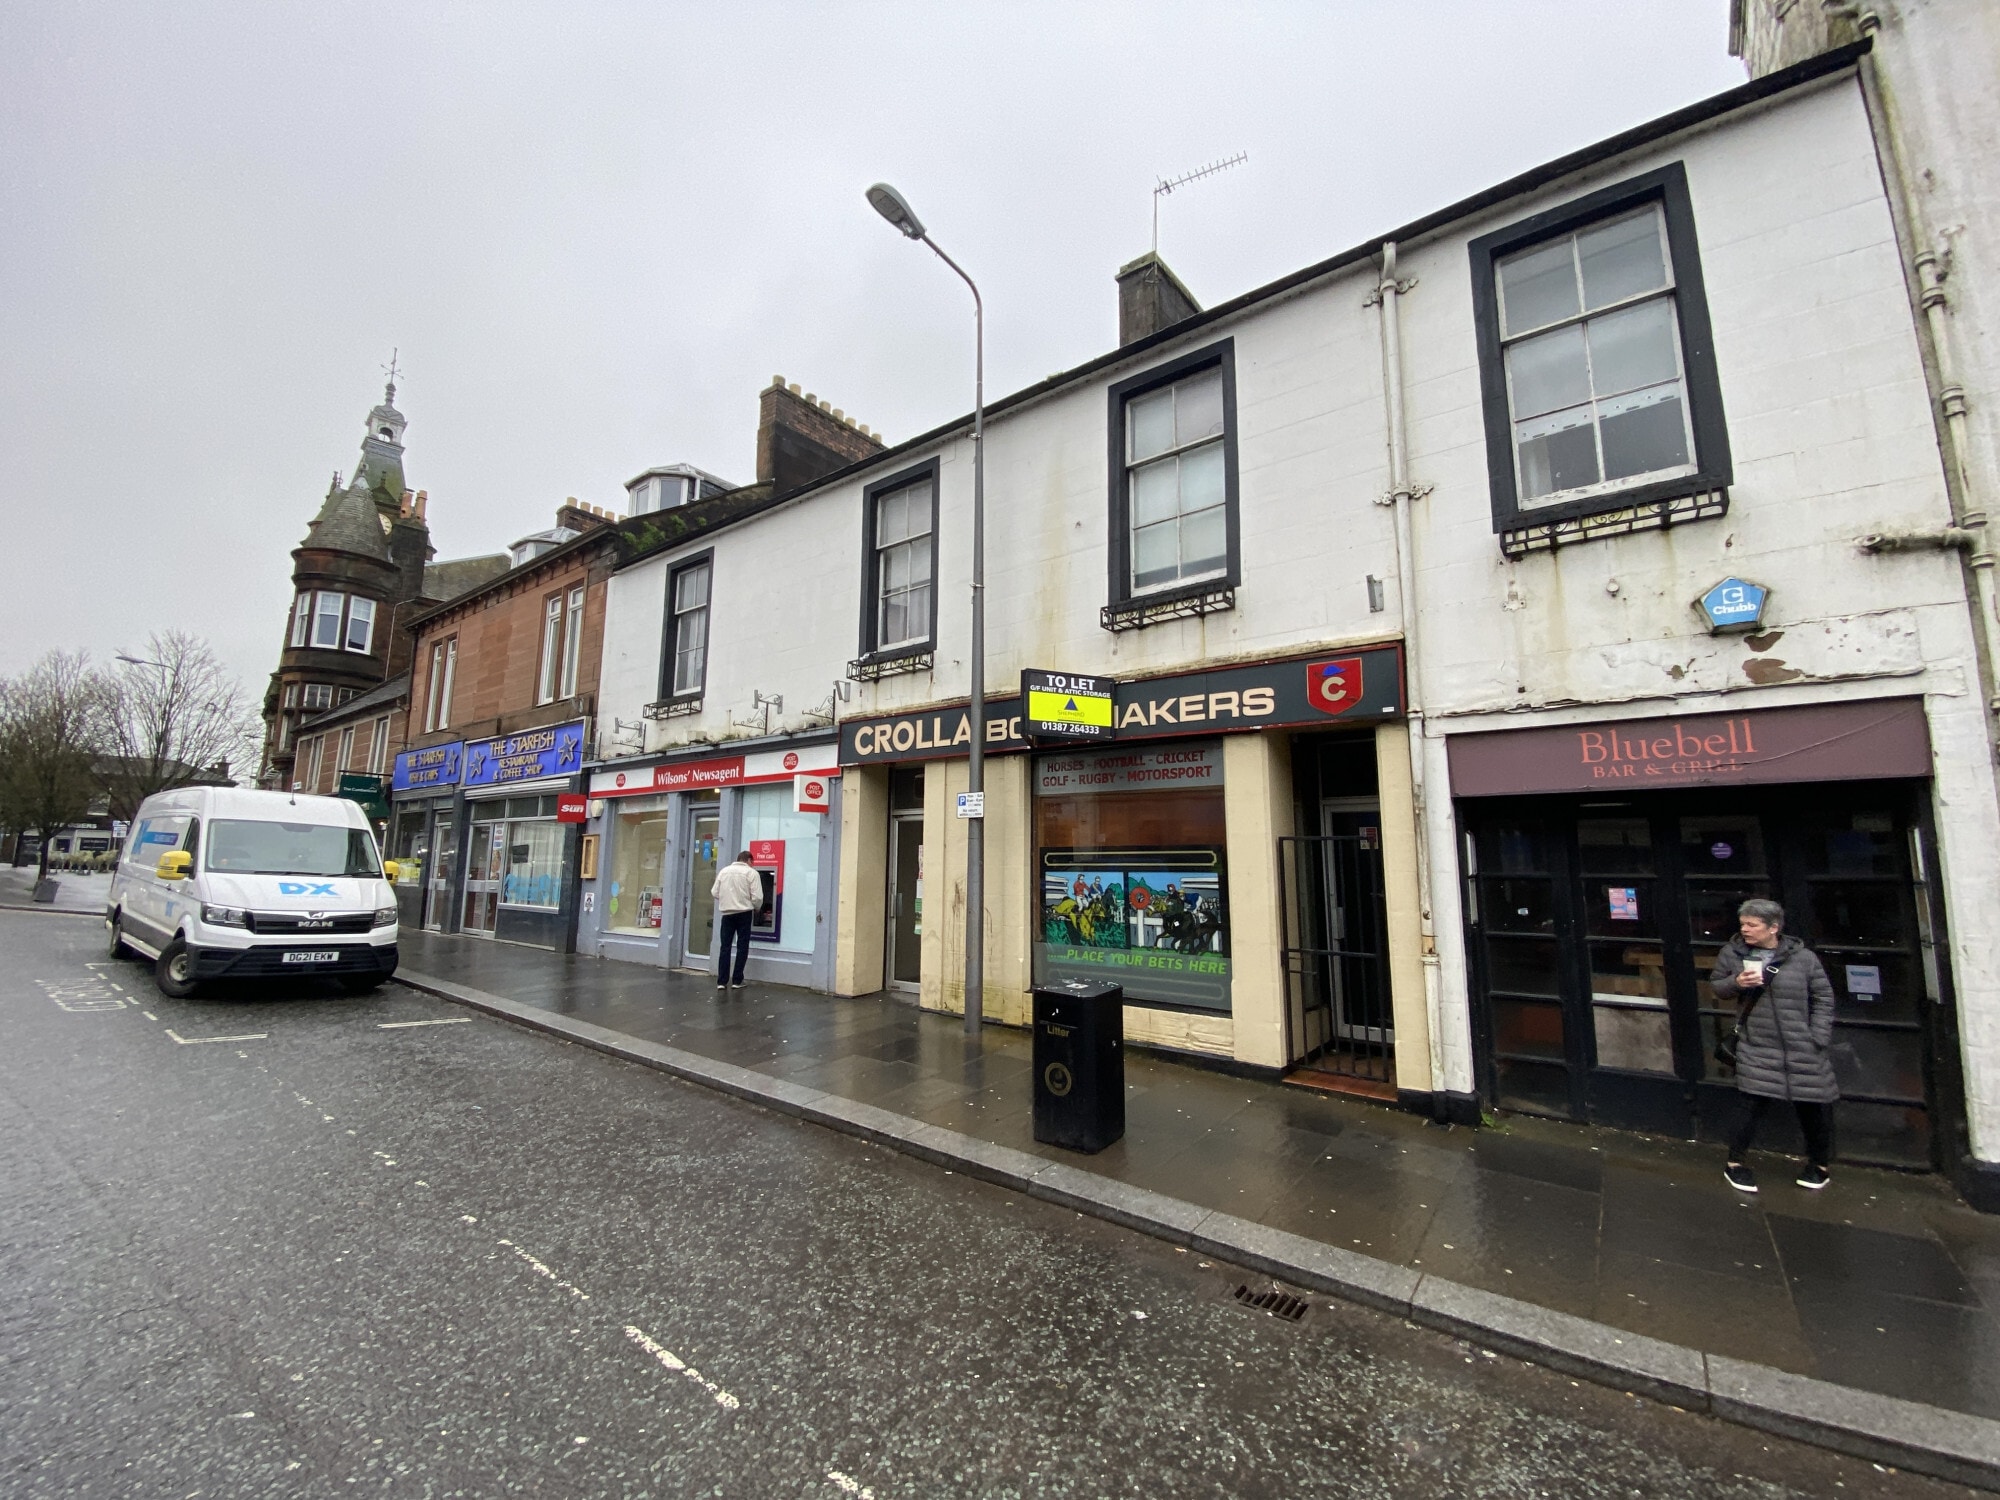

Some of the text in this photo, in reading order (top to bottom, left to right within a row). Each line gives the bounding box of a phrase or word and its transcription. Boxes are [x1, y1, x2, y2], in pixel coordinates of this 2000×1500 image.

[1713, 602, 1756, 614] Chubb
[1046, 675, 1095, 690] TO LET
[1321, 676, 1347, 701] C
[1083, 690, 1111, 698] STORAGE
[854, 714, 972, 756] CROLLA
[1041, 722, 1068, 732] 01387
[1069, 724, 1100, 734] 264333
[490, 731, 555, 756] THE STARFISH
[1577, 718, 1757, 764] Bluebell
[499, 754, 539, 769] RESTAURANT
[1047, 760, 1085, 773] HORSES
[1093, 756, 1146, 770] FOOTBALL
[1156, 750, 1206, 765] CRICKET
[1593, 759, 1744, 778] BAR & GRILL
[493, 764, 543, 780] & COFFEE SHOP
[692, 766, 740, 783] Newsagent
[1042, 776, 1069, 788] GOLF
[1078, 772, 1116, 785] RUGBY
[1127, 765, 1213, 782] MOTORSPORT
[561, 804, 584, 813] Sun
[279, 882, 338, 895] DX
[289, 952, 334, 962] DG21 EKW
[1110, 952, 1143, 967] YOUR
[1148, 955, 1183, 971] BETS
[1189, 960, 1227, 975] HERE
[1047, 1025, 1069, 1037] Litter
